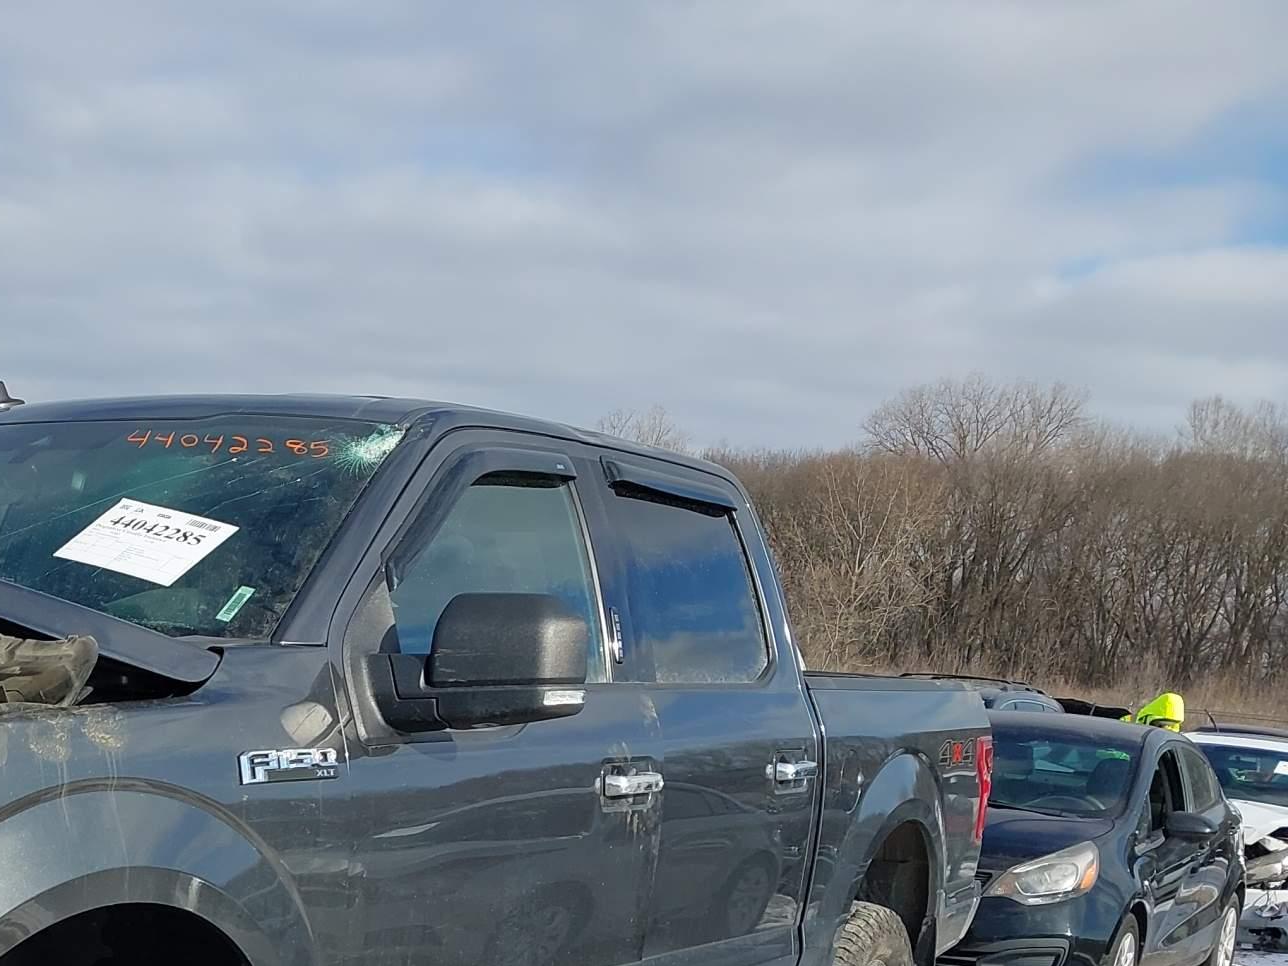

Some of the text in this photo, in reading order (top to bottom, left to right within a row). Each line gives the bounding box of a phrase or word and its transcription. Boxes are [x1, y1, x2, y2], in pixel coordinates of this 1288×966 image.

[127, 429, 331, 458] 44042285
[109, 515, 207, 546] 44042285
[315, 768, 336, 777] XLT
